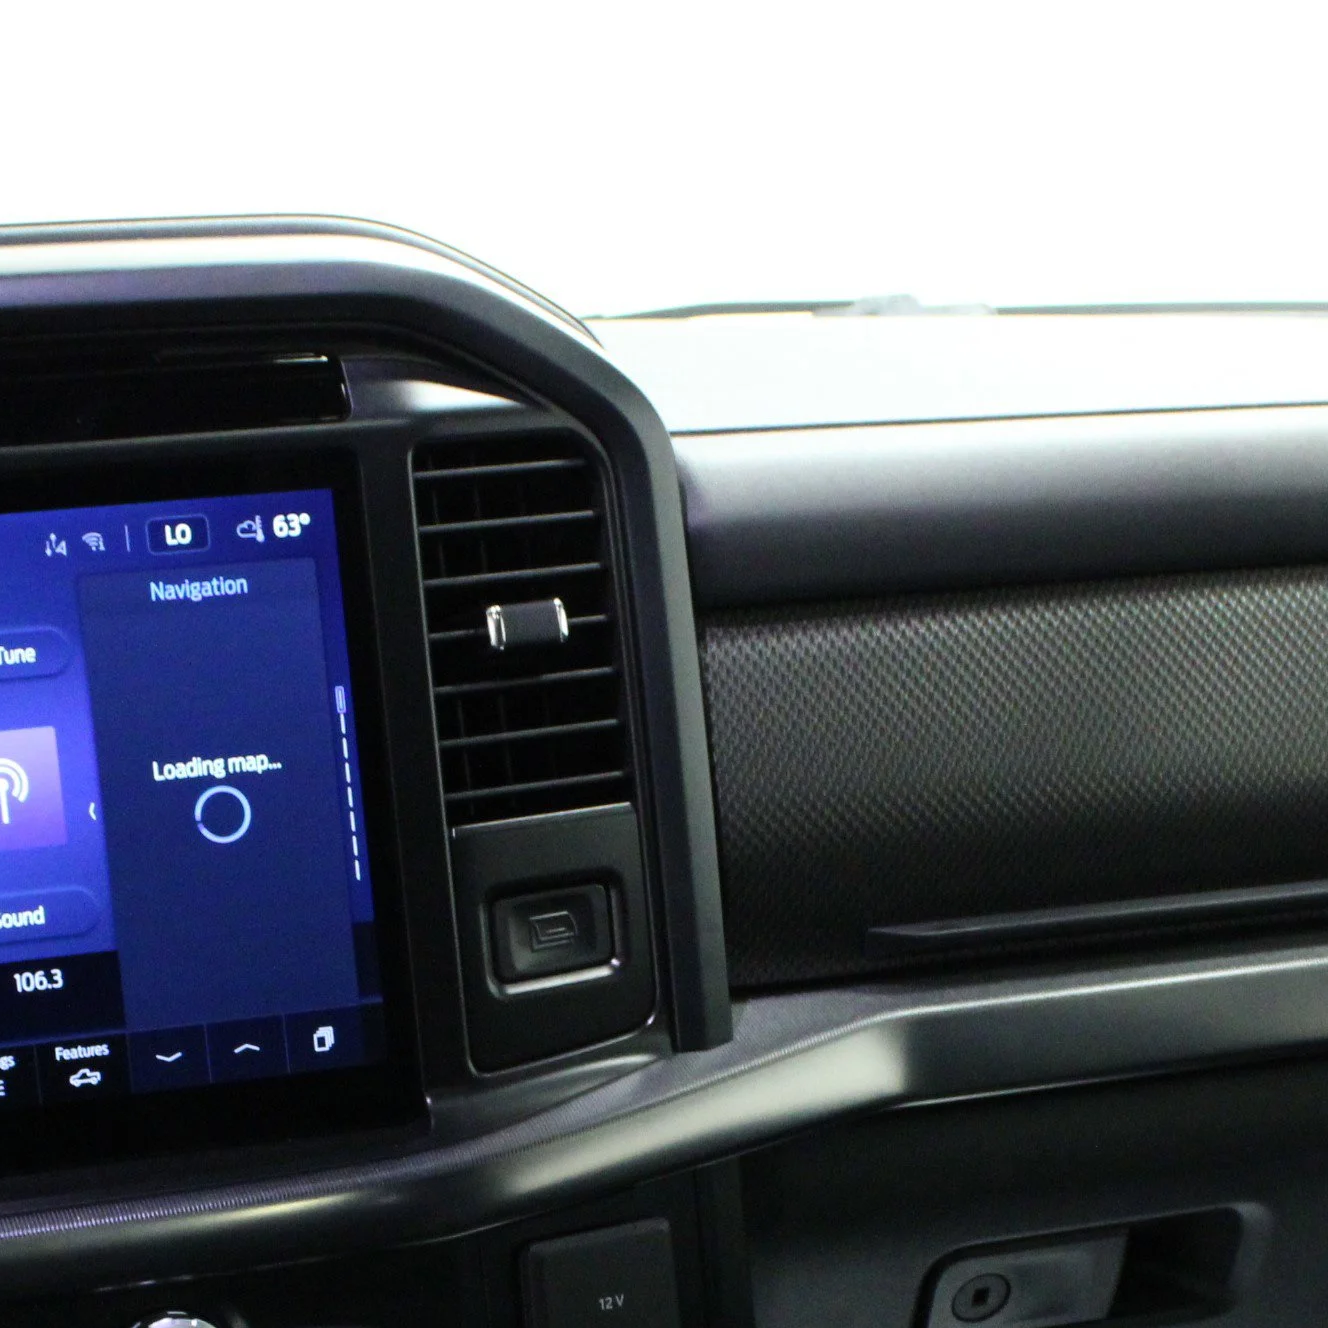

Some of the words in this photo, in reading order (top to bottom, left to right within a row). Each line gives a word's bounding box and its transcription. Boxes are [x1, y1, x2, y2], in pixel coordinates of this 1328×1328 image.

[164, 523, 193, 545] LO
[149, 576, 248, 602] Navigation
[152, 756, 225, 782] Loading
[227, 755, 282, 780] map...
[13, 967, 65, 995] 106.3
[54, 1042, 110, 1062] Features
[598, 1297, 613, 1311] 12
[613, 1294, 625, 1307] V
